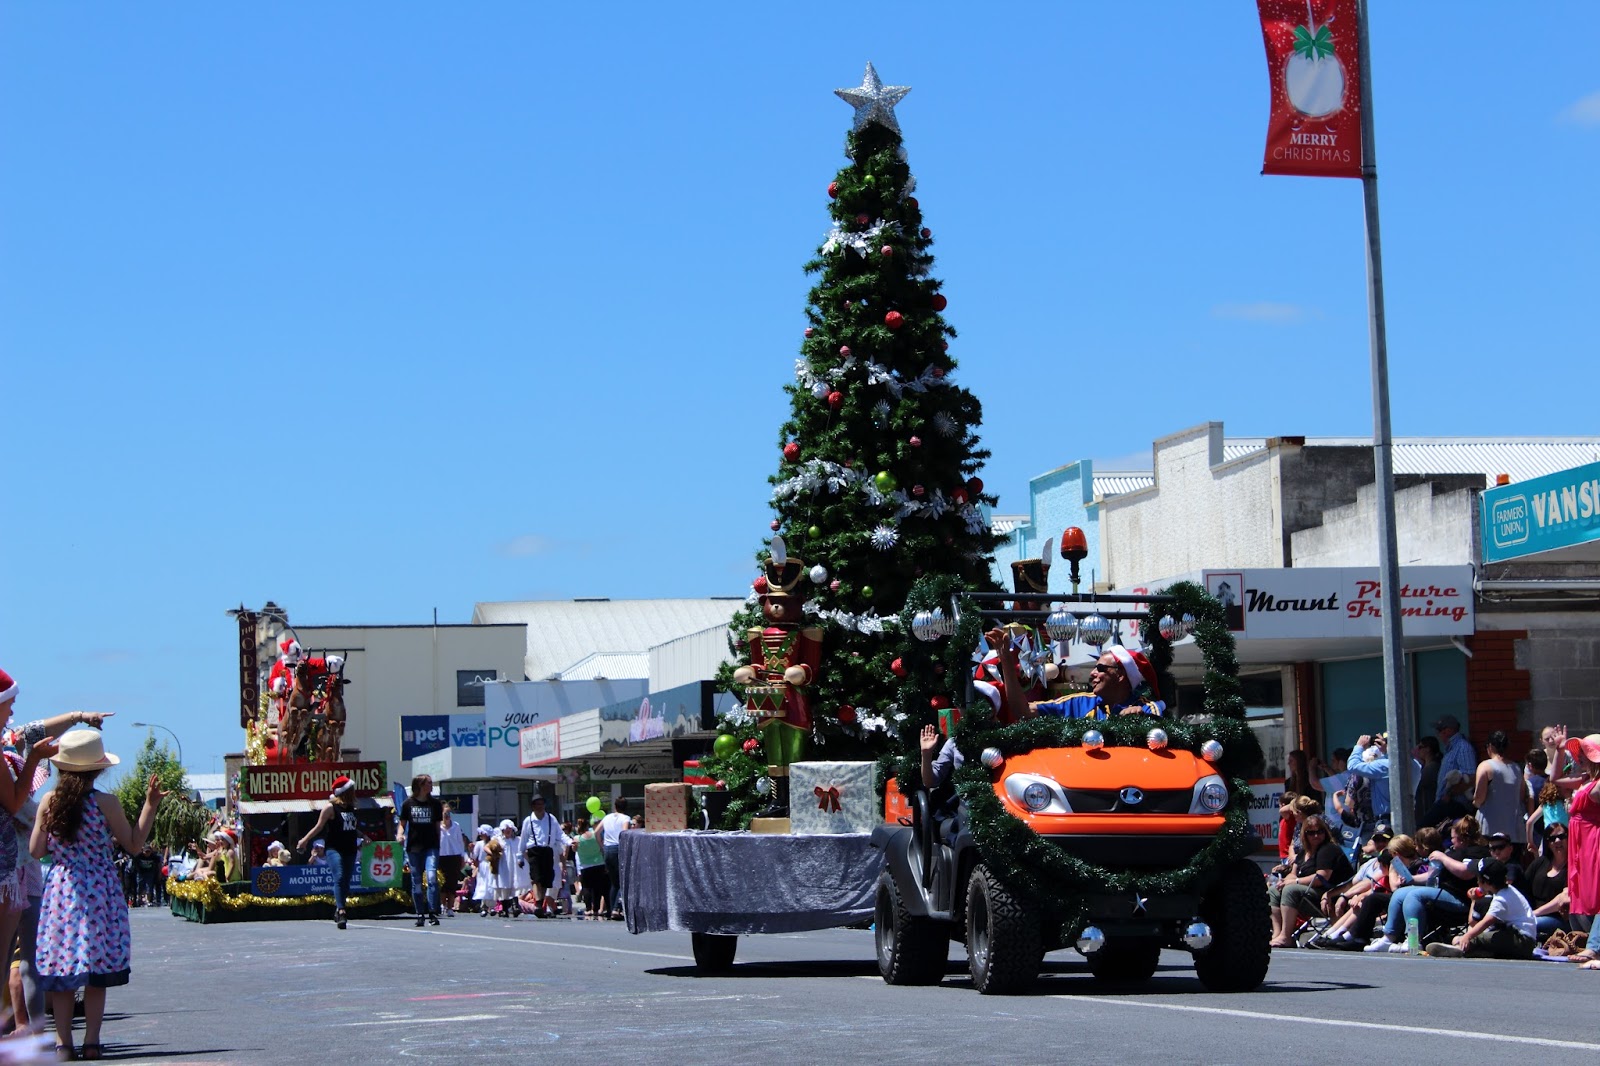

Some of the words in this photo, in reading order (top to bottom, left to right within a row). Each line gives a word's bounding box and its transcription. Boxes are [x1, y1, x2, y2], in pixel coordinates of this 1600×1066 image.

[1290, 133, 1338, 146] MERRY
[1273, 147, 1351, 162] CHRISTMAS
[1496, 506, 1524, 523] FARMERS
[1355, 581, 1459, 598] Piture
[1245, 589, 1340, 612] Mount
[1347, 600, 1469, 622] Frming
[241, 637, 255, 717] ODEON
[501, 713, 539, 728] your
[414, 727, 446, 745] pet
[452, 729, 487, 747] vet
[592, 763, 638, 778] Capelli
[250, 772, 297, 794] MERRY
[301, 867, 318, 875] THE
[373, 864, 391, 876] 52
[289, 876, 323, 884] MOUNT
